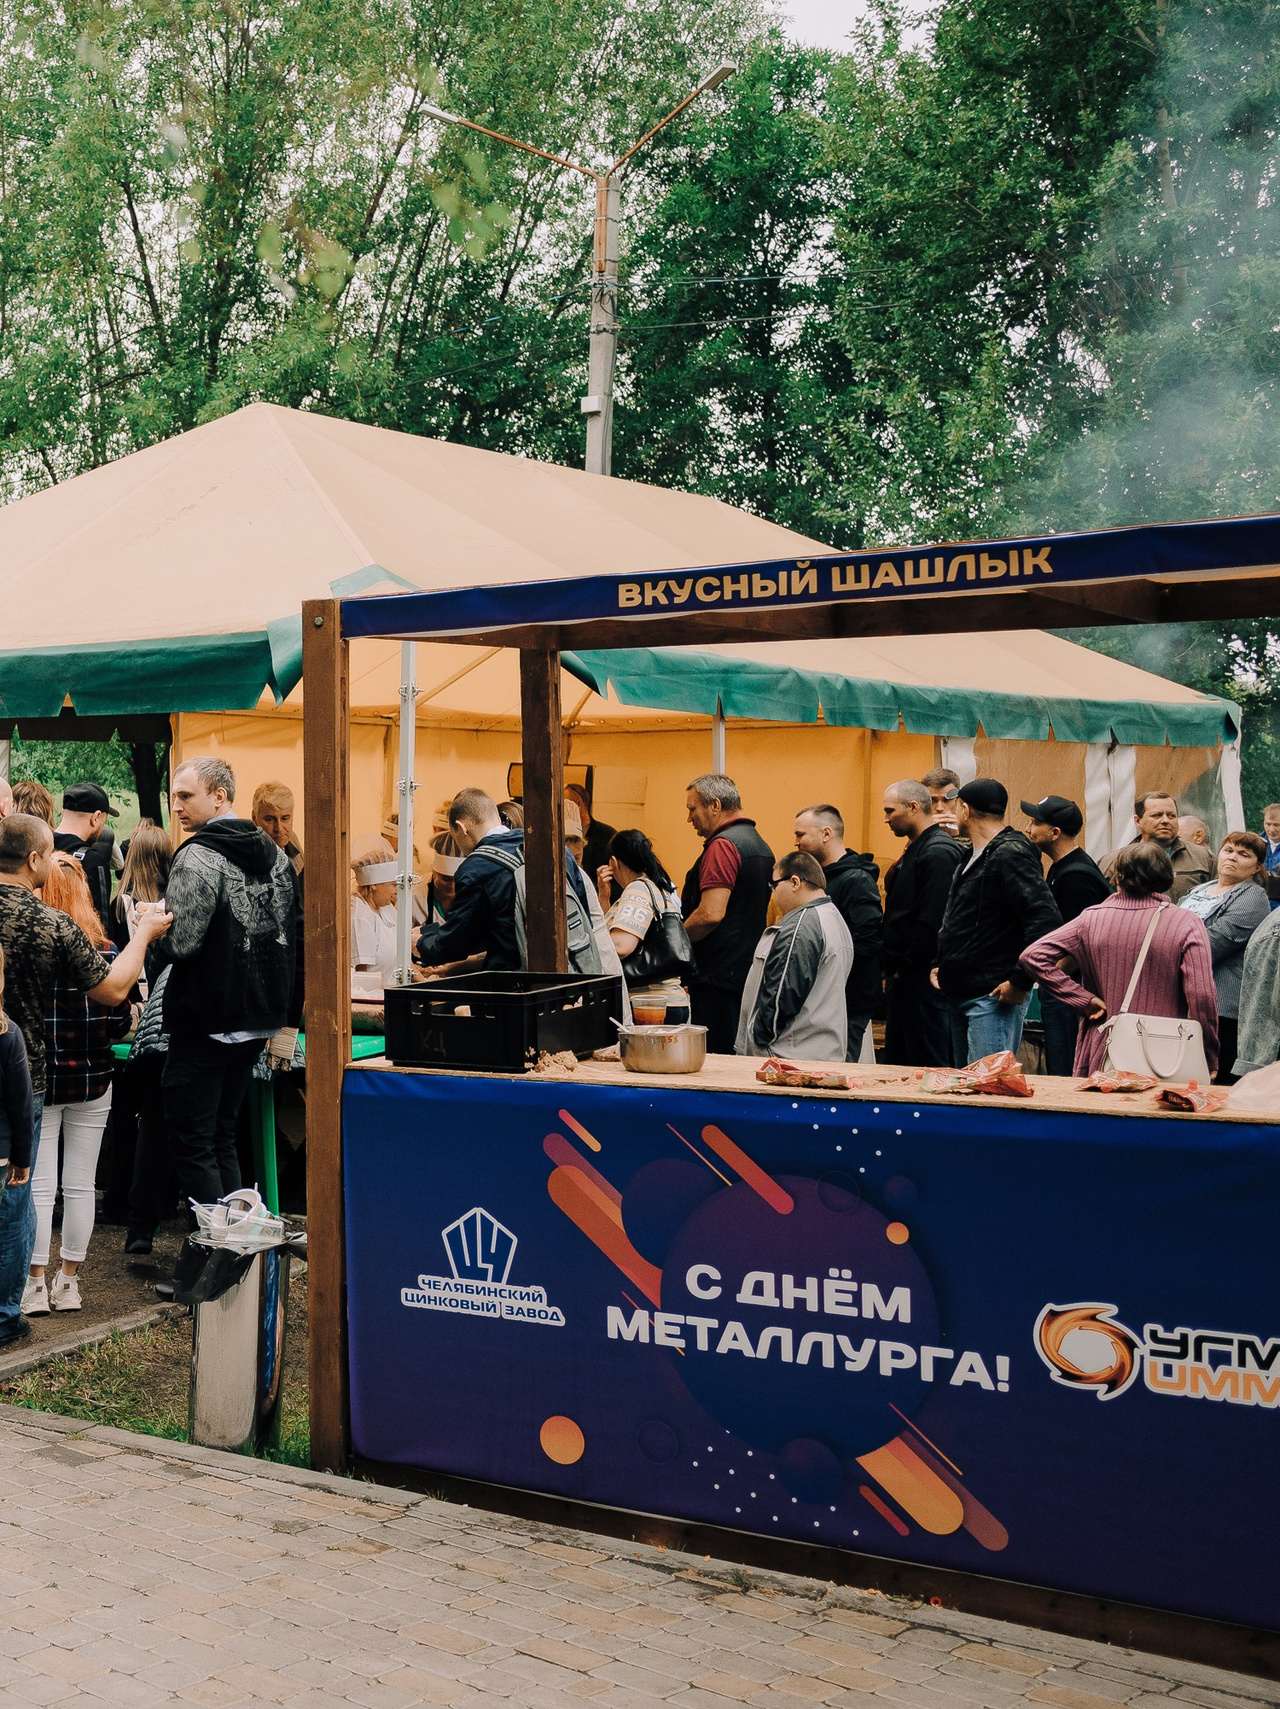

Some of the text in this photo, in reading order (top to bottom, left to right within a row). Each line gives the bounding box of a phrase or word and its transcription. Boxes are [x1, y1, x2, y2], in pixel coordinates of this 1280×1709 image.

[617, 546, 1054, 608] ВКУСНЫЙ ШАШЛЫК
[404, 1291, 562, 1323] ЦИНКОВЫЙ ЗАВОД
[421, 1278, 544, 1304] ЧЕЛЯБИНСКИЙ
[685, 1263, 912, 1324] С ДНЁМ
[606, 1305, 1011, 1393] МЕТАЛЛУРГА!
